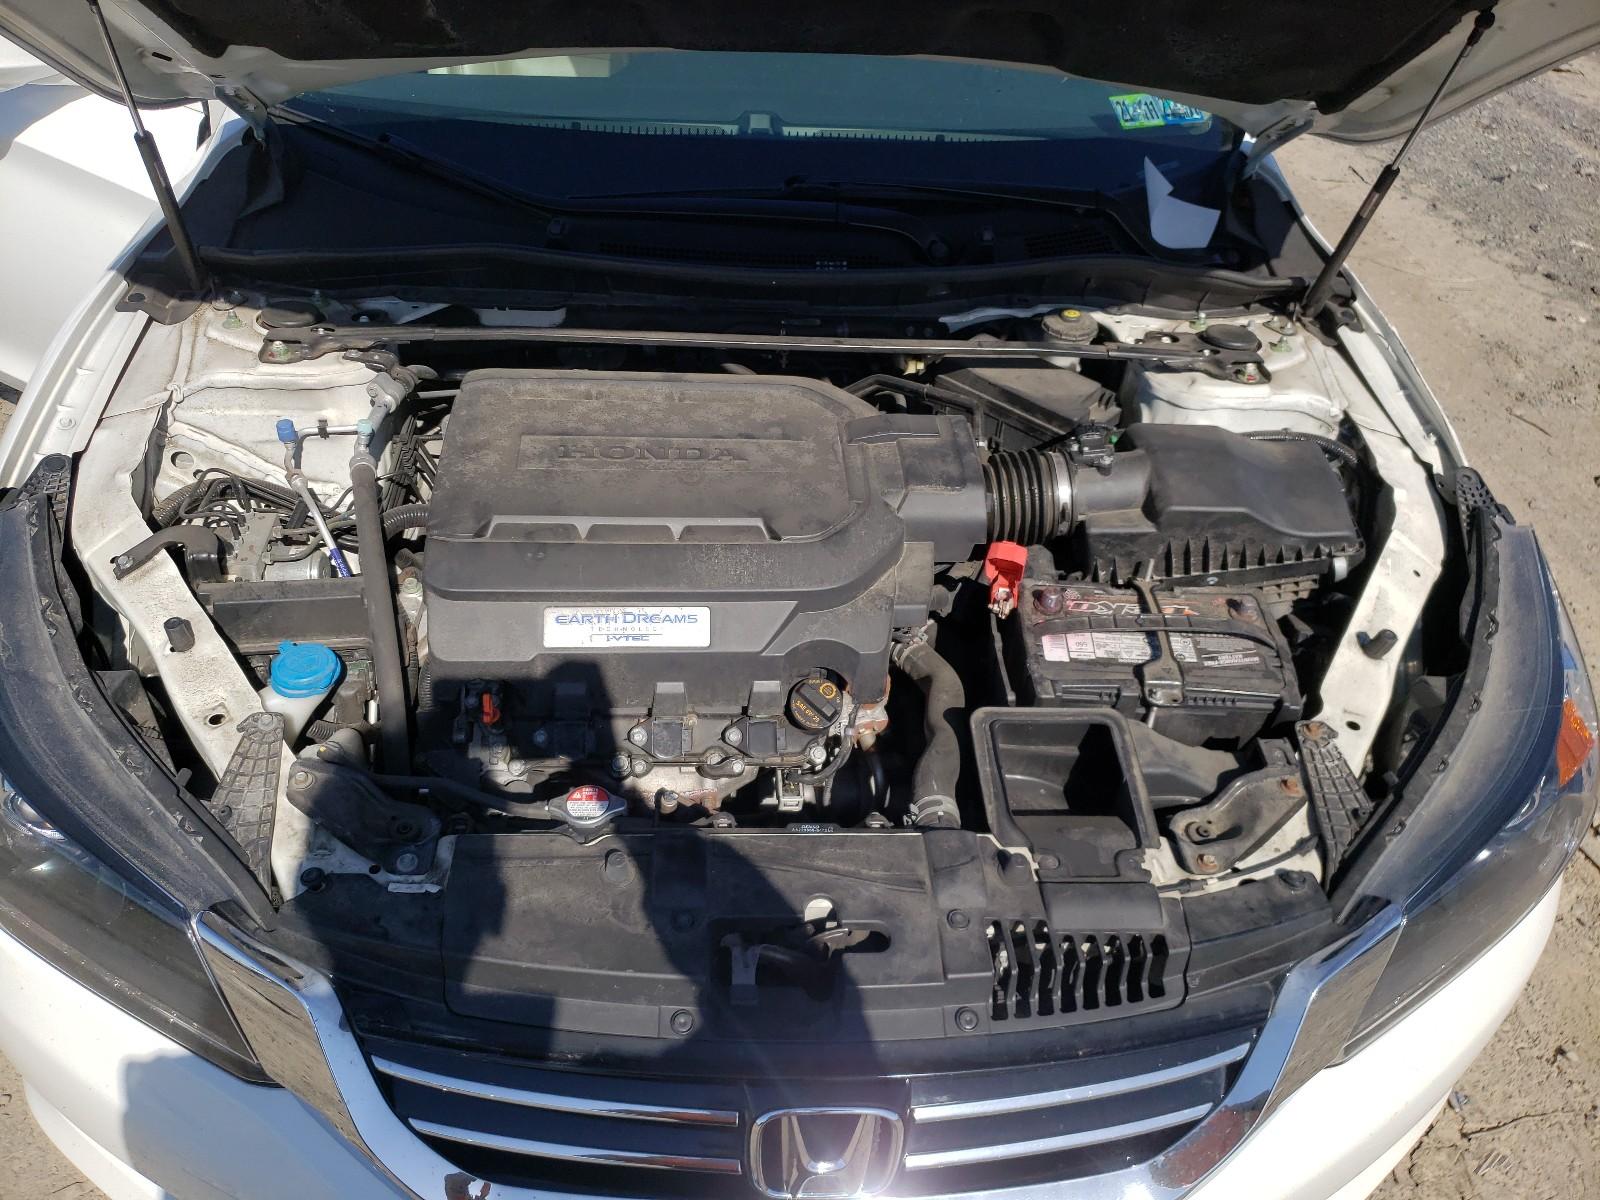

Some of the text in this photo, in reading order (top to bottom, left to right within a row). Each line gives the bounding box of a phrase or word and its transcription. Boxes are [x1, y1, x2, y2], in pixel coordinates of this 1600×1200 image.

[558, 445, 749, 462] HONDA
[555, 611, 699, 624] EARTH DREAMS
